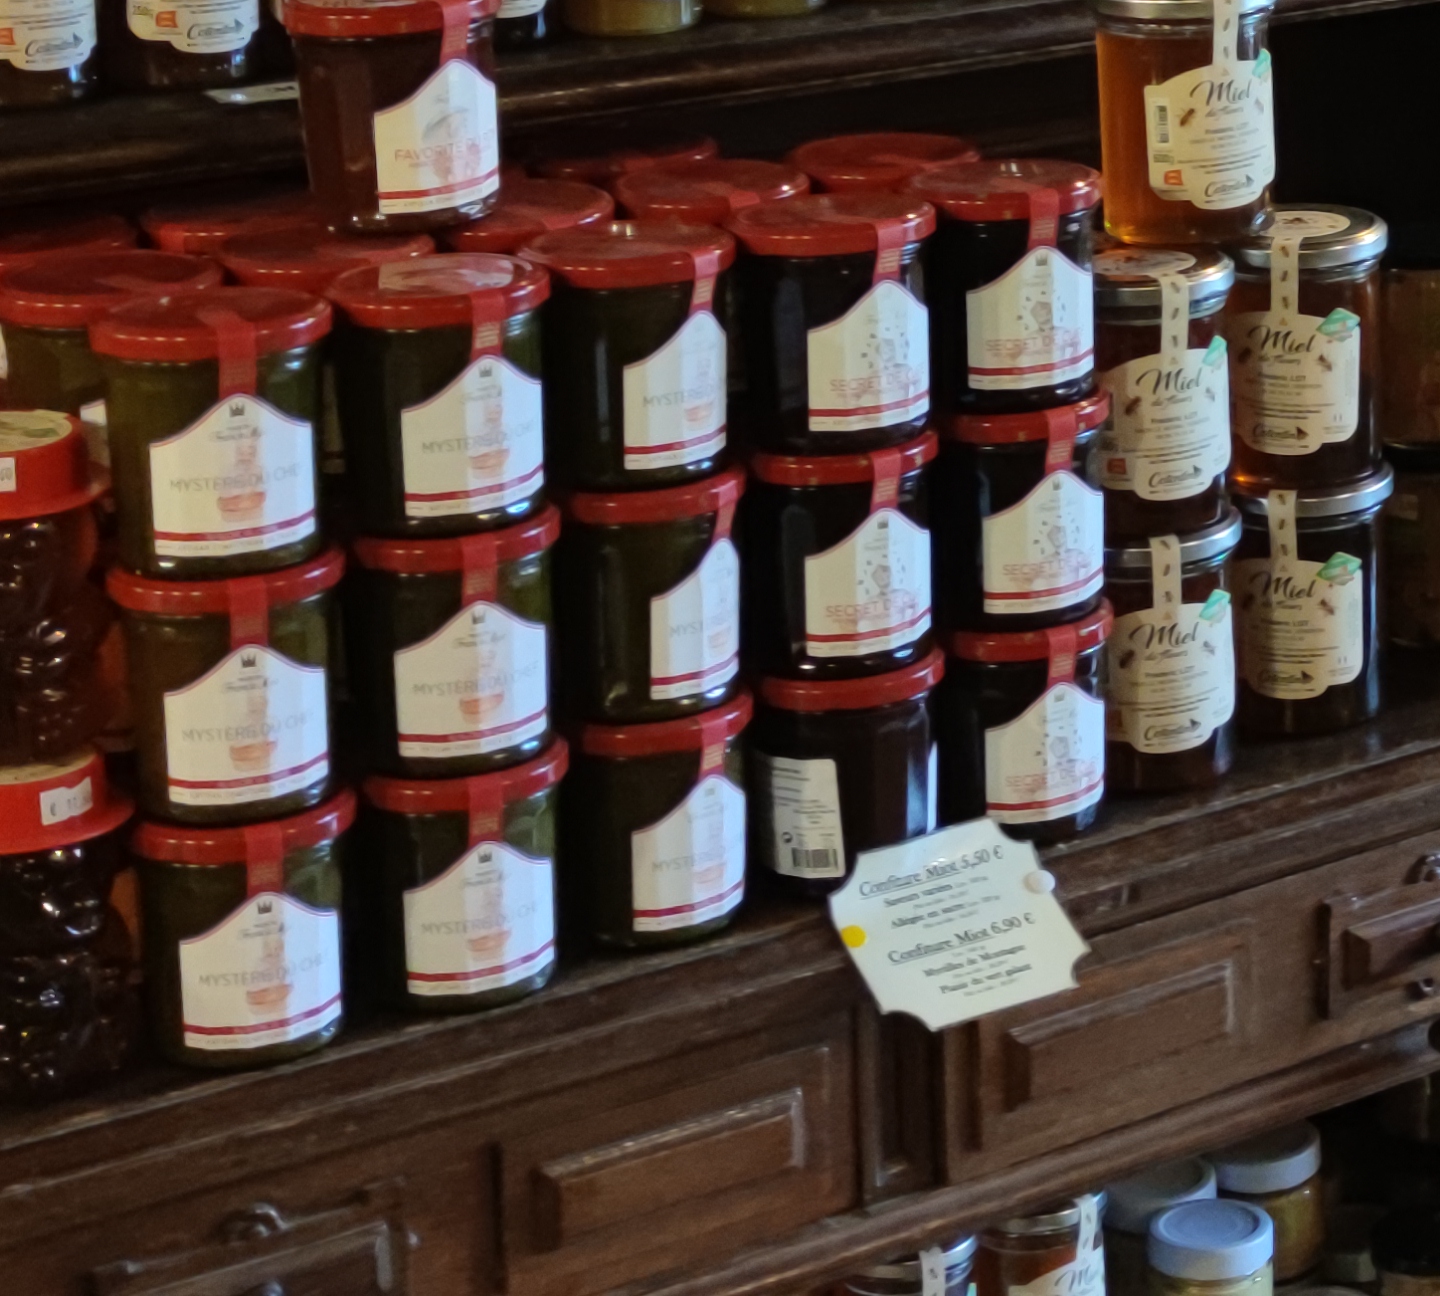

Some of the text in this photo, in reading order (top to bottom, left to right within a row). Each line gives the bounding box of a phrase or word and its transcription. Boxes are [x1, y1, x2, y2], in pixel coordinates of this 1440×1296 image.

[1190, 78, 1252, 106] Miel
[394, 142, 463, 163] FAVORITE
[1248, 324, 1317, 356] Miel
[1135, 369, 1202, 397] Miel
[1251, 571, 1318, 600] Miel
[1129, 621, 1200, 650] Miel
[859, 844, 1003, 898] Confiture Miot 5,50 €
[887, 912, 1036, 964] Confiture Miot 6,90 €
